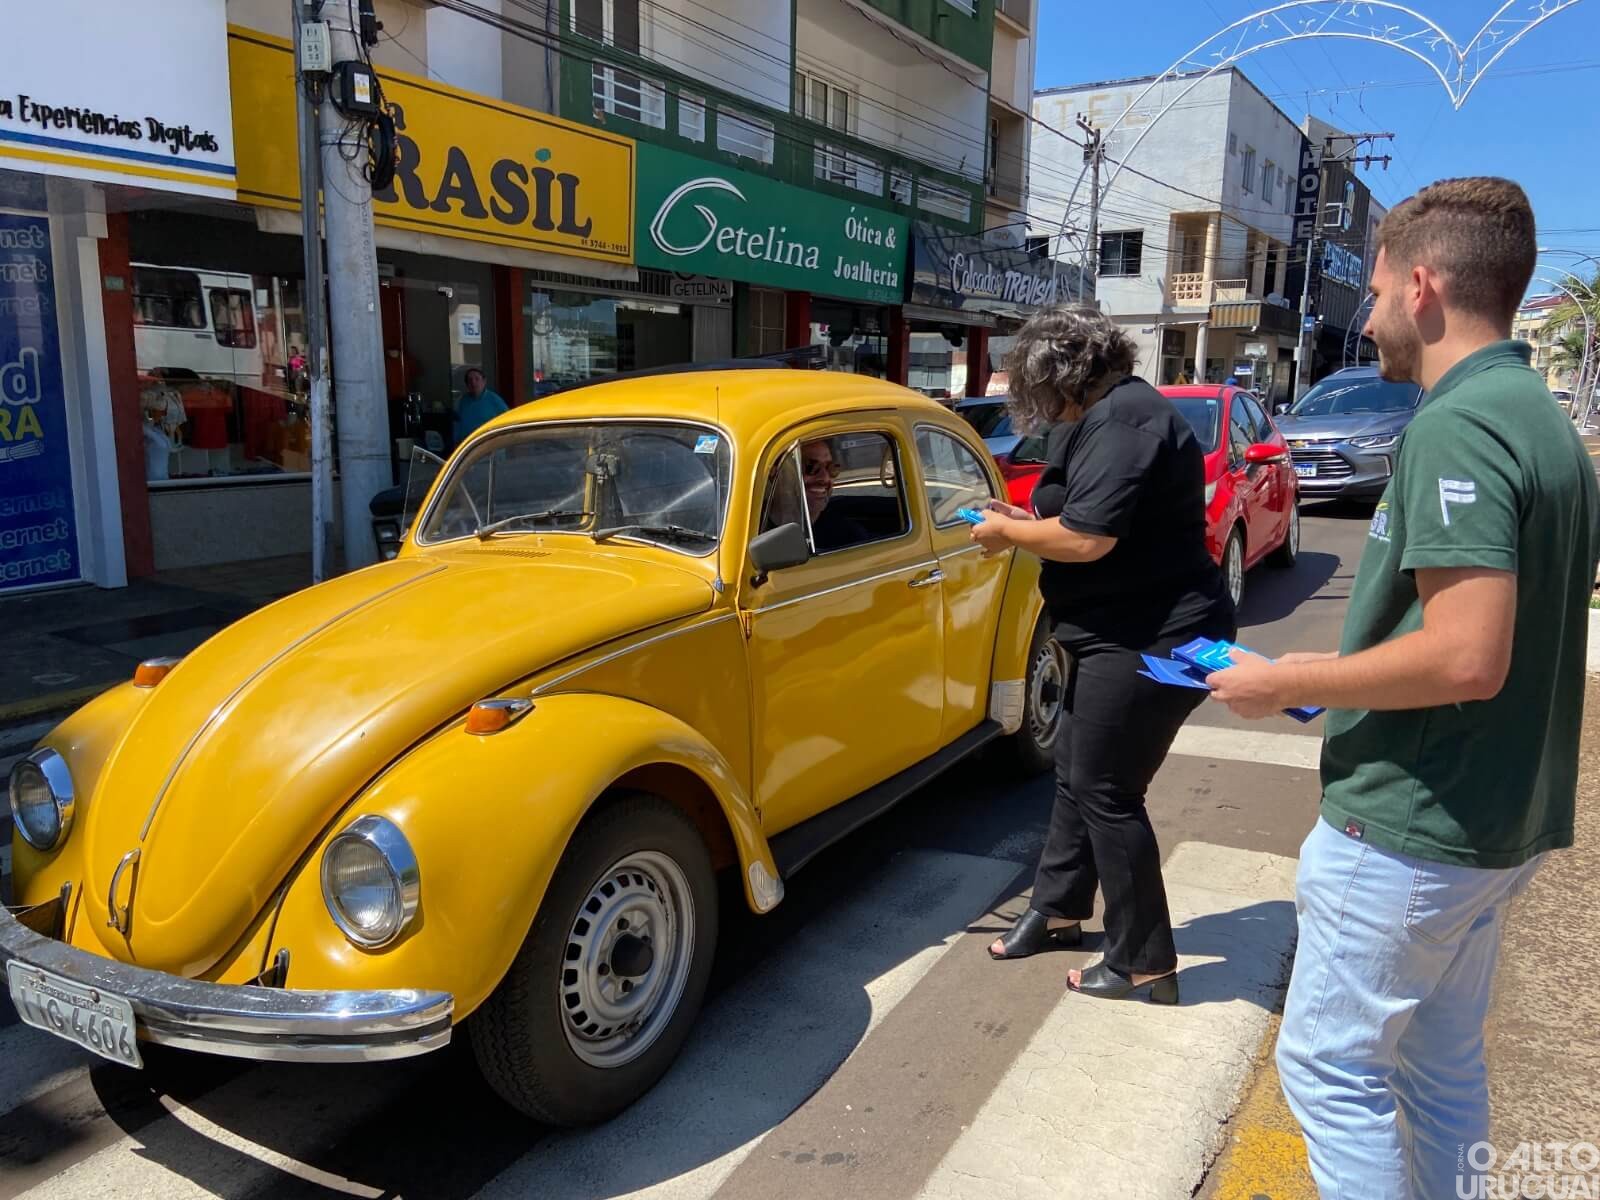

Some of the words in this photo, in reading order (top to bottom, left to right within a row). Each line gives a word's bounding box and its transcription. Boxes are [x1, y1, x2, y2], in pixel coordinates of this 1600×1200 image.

[18, 94, 142, 140] Experiências
[145, 116, 219, 154] Digitais
[372, 134, 593, 239] RASIL
[650, 177, 820, 270] Getelina
[845, 206, 881, 246] Ótica
[885, 227, 897, 249] &
[674, 283, 728, 297] GETELINA
[834, 256, 898, 288] Joalheria
